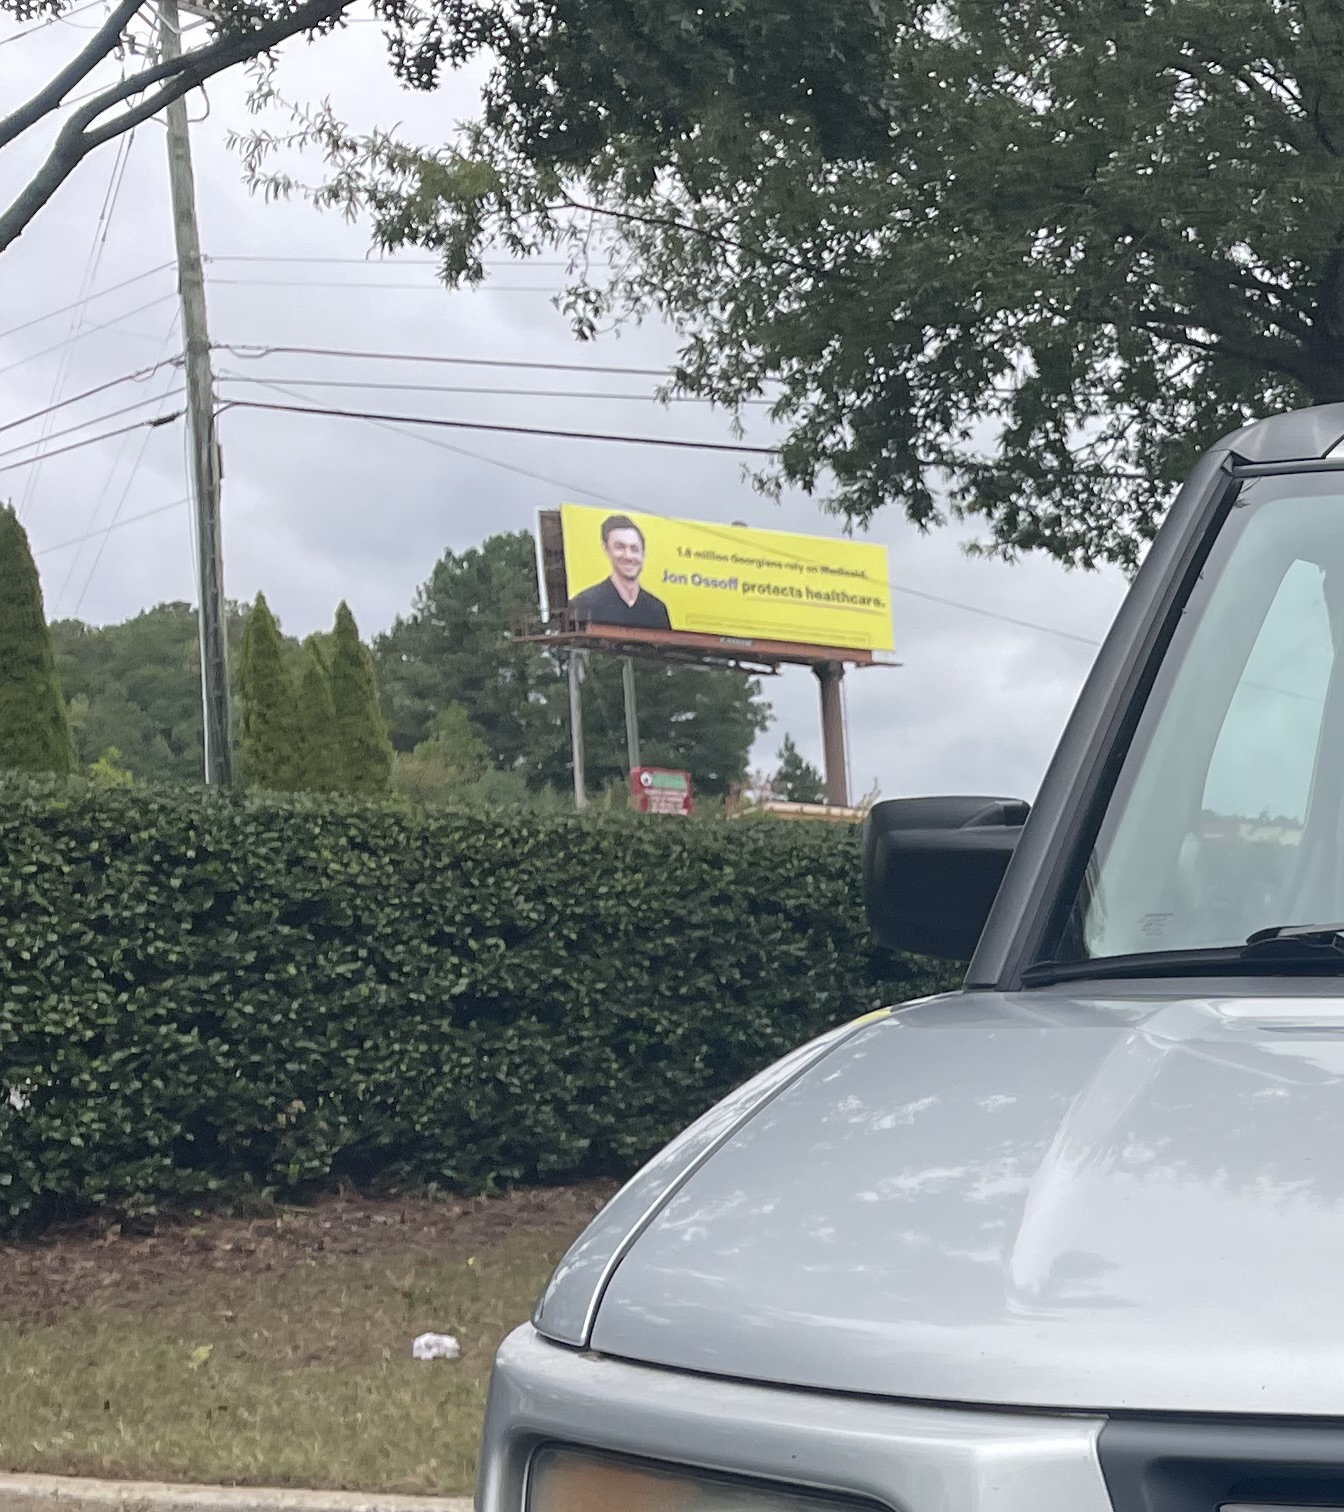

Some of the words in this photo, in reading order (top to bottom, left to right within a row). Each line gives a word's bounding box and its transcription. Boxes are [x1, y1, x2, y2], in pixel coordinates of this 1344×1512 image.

[694, 551, 728, 562] million
[731, 553, 782, 569] Georgians
[785, 561, 804, 574] rely
[662, 569, 688, 585] Jon
[691, 573, 738, 591] Ossoff
[742, 581, 802, 599] protects
[805, 585, 886, 608] healthcare.
